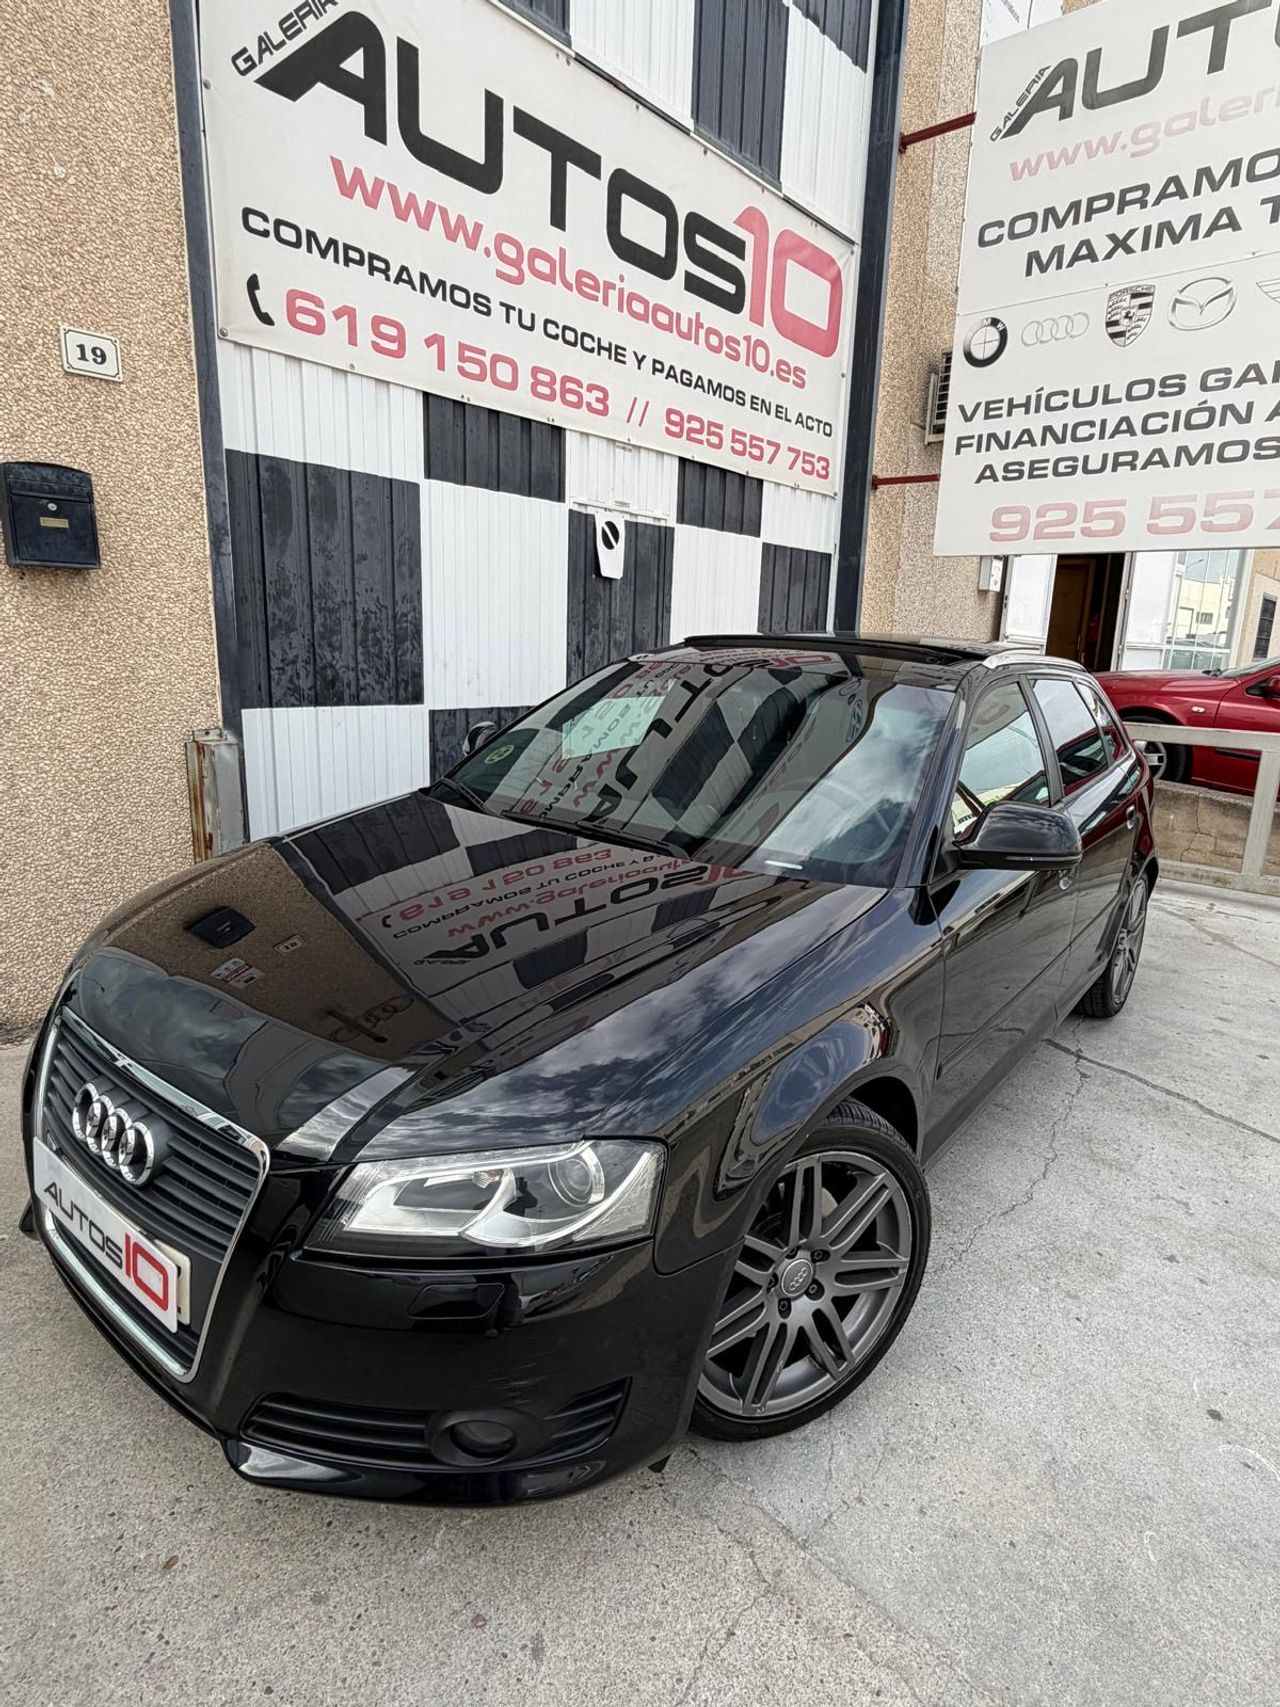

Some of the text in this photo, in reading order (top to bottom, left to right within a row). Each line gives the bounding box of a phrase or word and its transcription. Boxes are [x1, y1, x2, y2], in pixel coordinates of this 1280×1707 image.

[990, 65, 1051, 141] GALERIA
[1000, 0, 1280, 139] AUT
[254, 11, 843, 358] AUTOS10
[329, 155, 807, 389] www.galeriaautos10.es
[1025, 206, 1242, 277] MAXIMA
[76, 343, 107, 365] 19
[242, 206, 833, 437] COMPRAMOS TU COCHE Y PAGAMOS EN EL ACTO
[286, 289, 406, 359] 619
[424, 333, 519, 391] 150
[530, 365, 610, 417] 863
[665, 408, 724, 450] 925
[731, 429, 781, 465] 557
[788, 446, 831, 480] 753
[958, 374, 1187, 423] VEHÍCULOS
[955, 400, 1254, 455] FINANCIACIÓN
[975, 436, 1280, 484] ASEGURAMOS
[989, 499, 1127, 542] 925
[44, 1182, 169, 1312] AUTOS10
